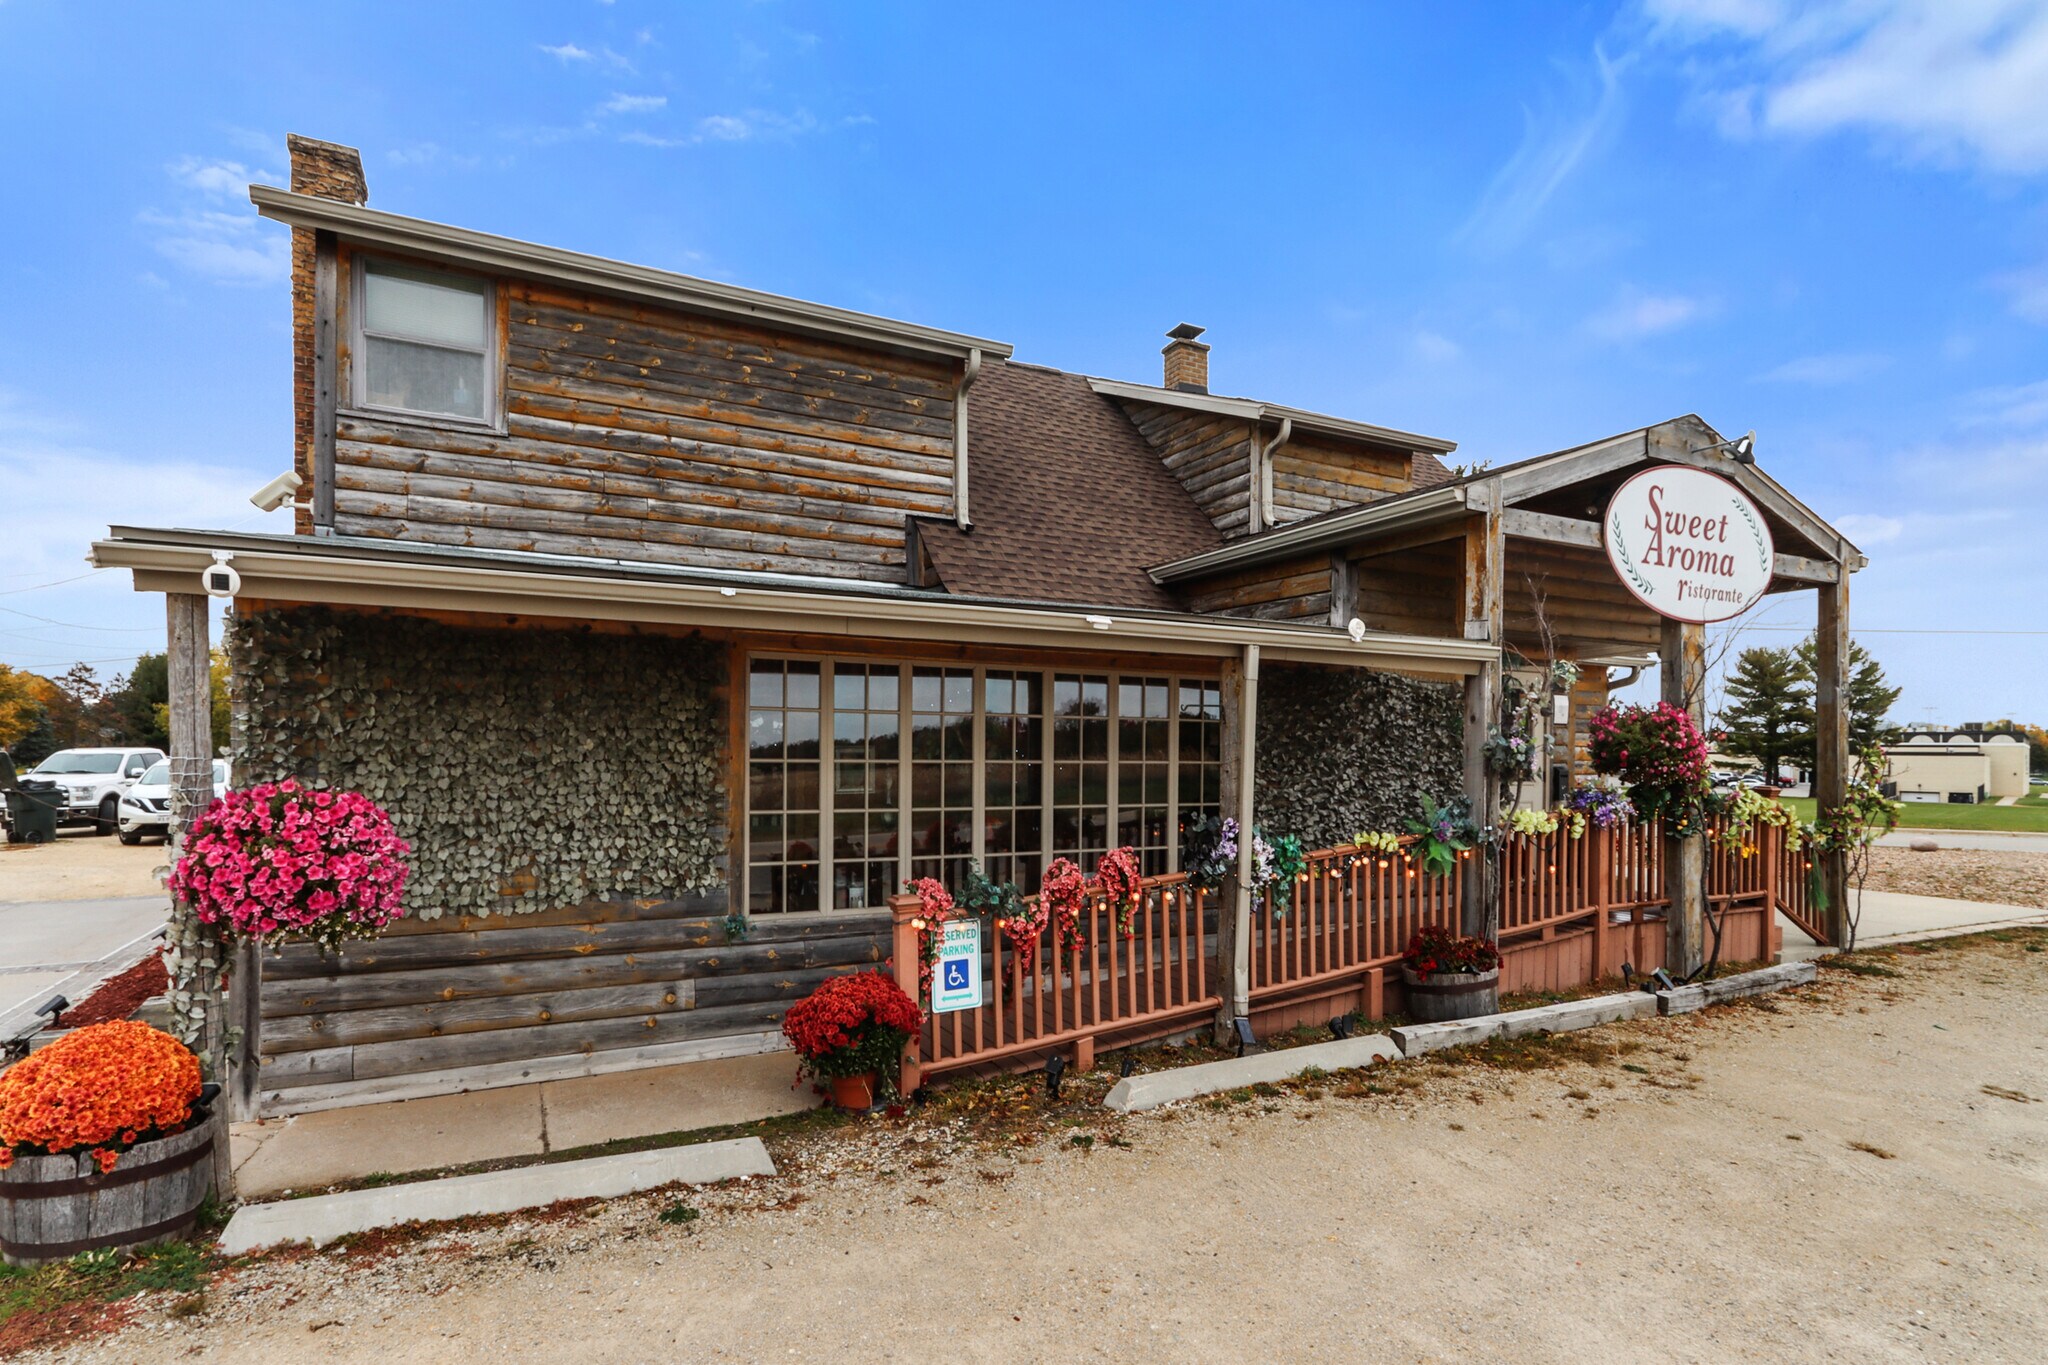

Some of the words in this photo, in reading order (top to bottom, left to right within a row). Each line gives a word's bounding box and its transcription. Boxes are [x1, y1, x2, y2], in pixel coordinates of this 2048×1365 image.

[1645, 485, 1728, 543] Sweet
[1641, 530, 1735, 577] Aroma
[1677, 579, 1743, 604] ristorante
[945, 929, 977, 941] SERVED
[938, 943, 975, 956] PARKING
